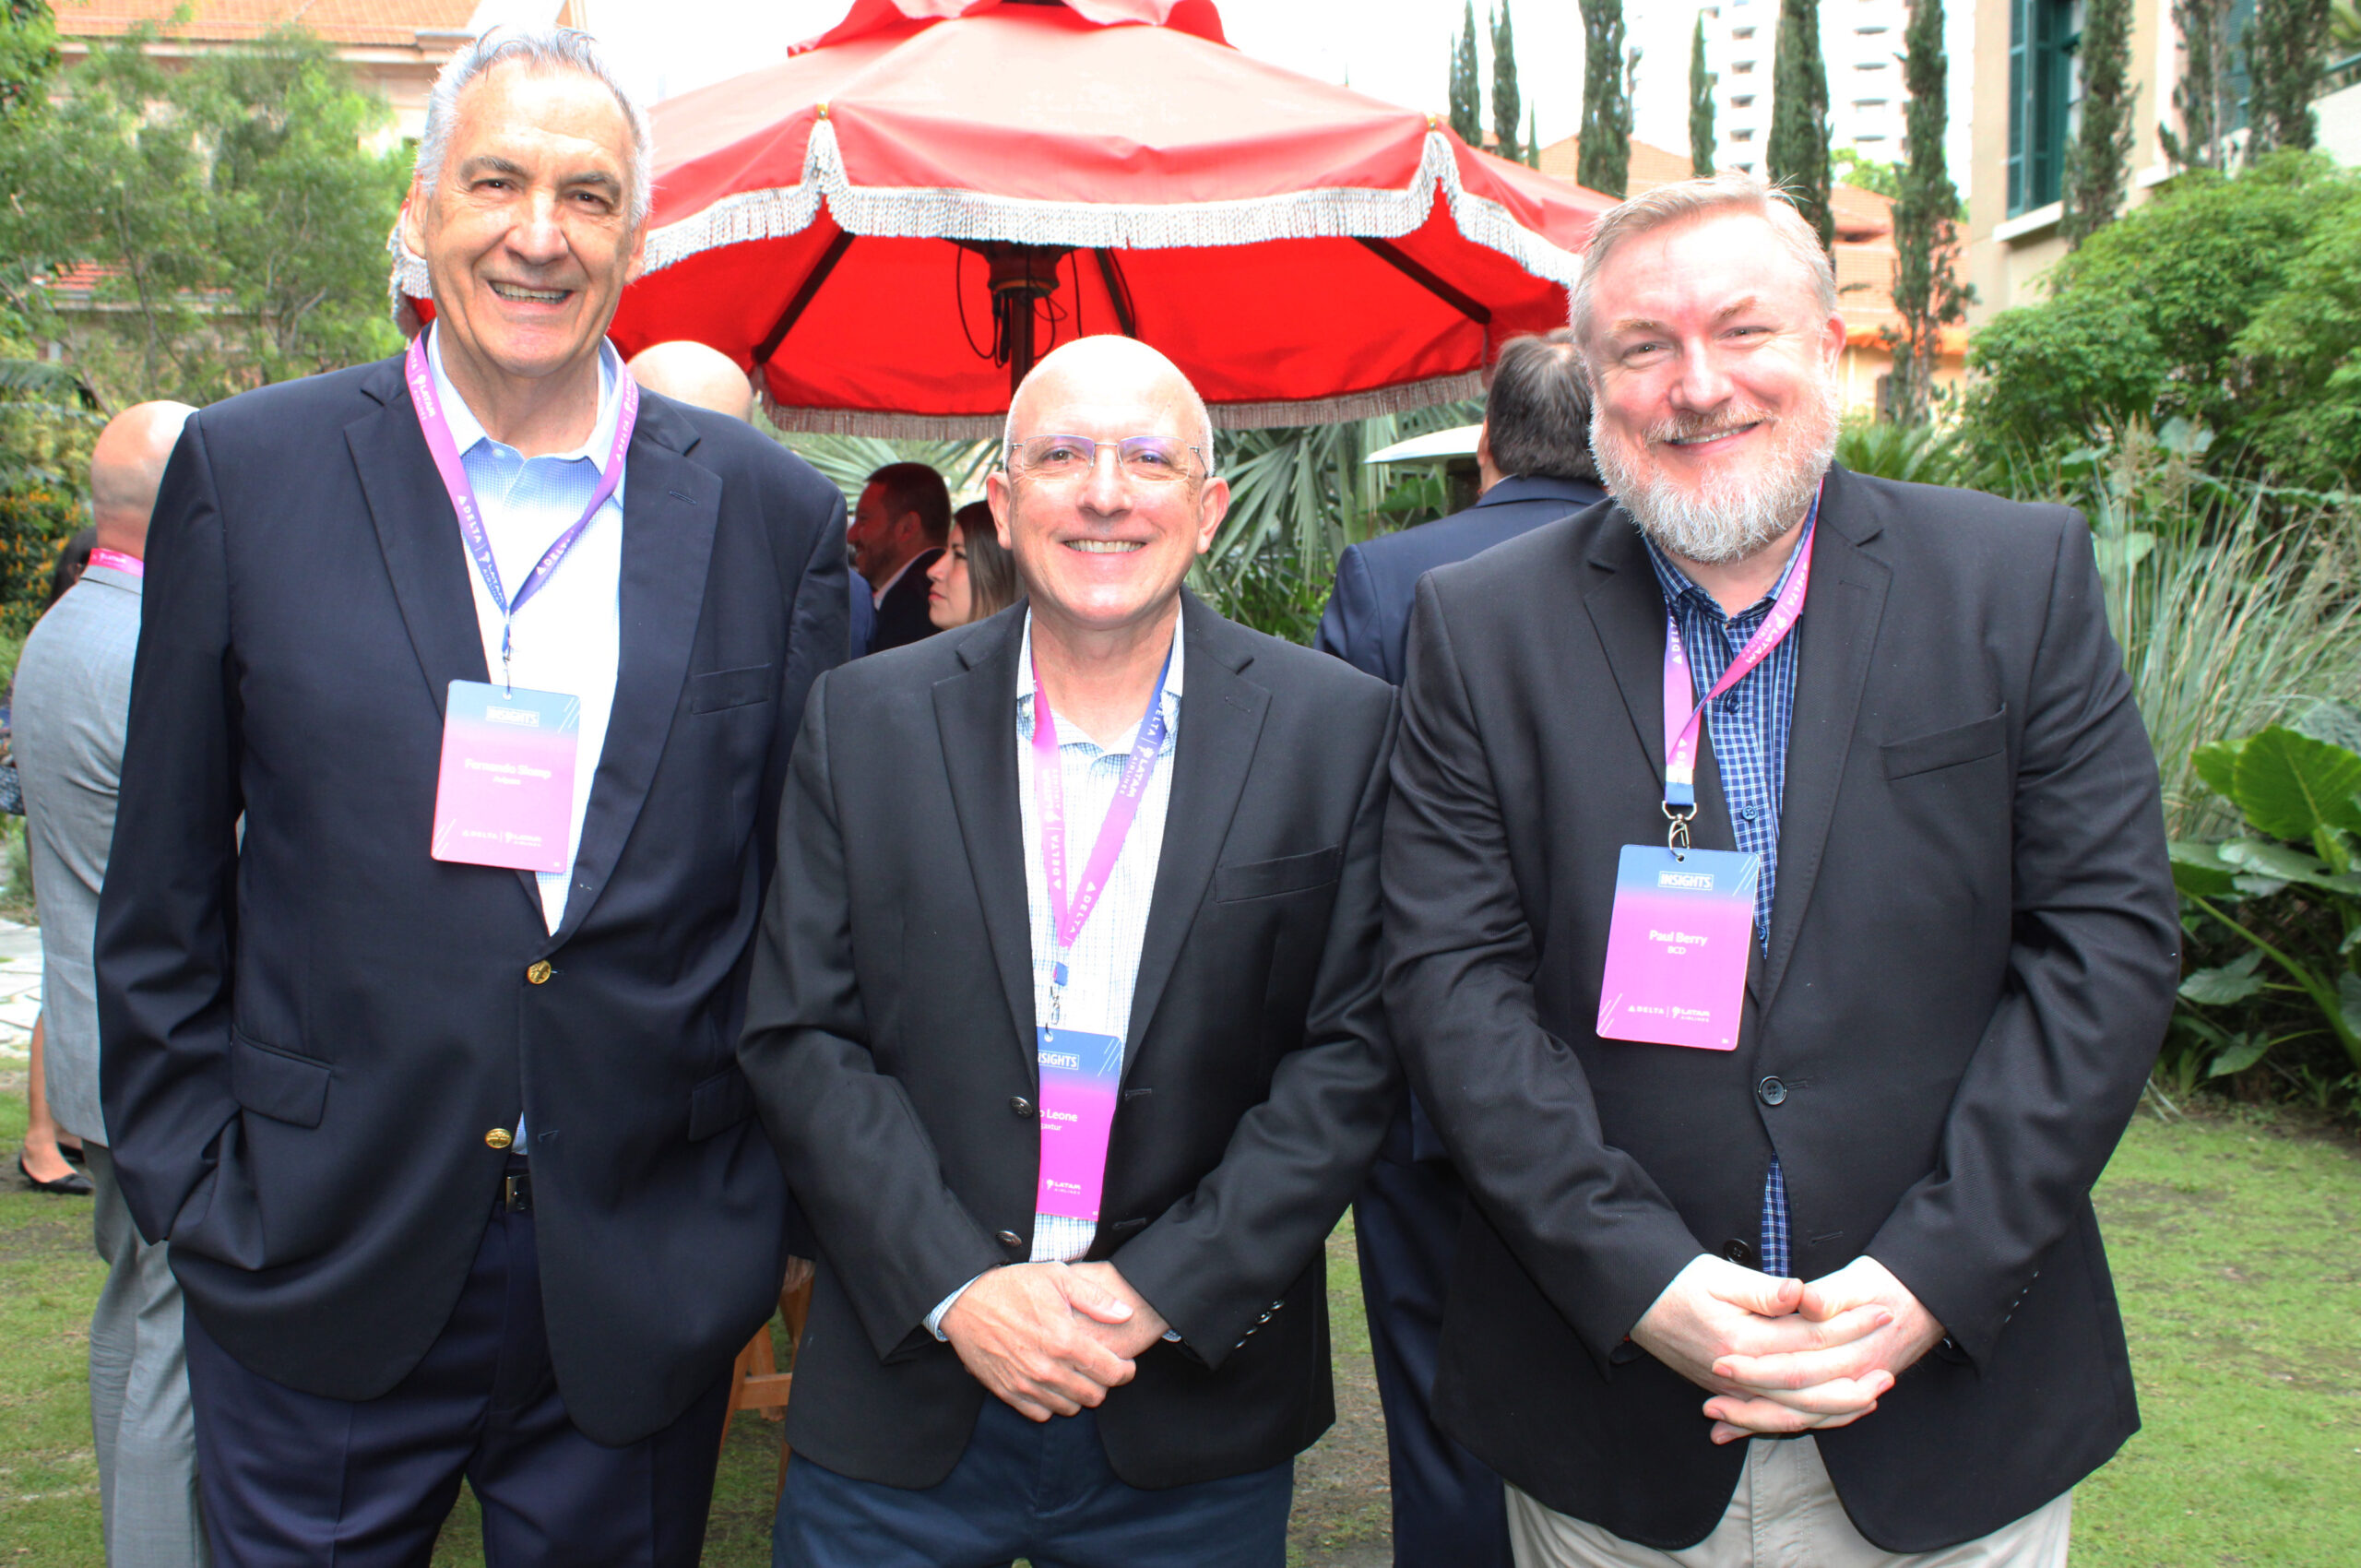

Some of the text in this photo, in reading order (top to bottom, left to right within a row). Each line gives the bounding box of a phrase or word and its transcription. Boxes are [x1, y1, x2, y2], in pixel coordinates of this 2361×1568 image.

[463, 505, 504, 603] DELTA LATAM
[543, 539, 570, 566] DELT
[1746, 572, 1806, 663] DELTA LATAM
[1126, 758, 1148, 798] LATAM
[1050, 835, 1061, 876] DELTA
[1660, 873, 1711, 888] INSIGHTS
[1070, 895, 1092, 933] DELTA
[1649, 930, 1709, 946] Paul Berry
[1667, 945, 1687, 956] BCD
[1636, 1005, 1665, 1015] DELTA
[1046, 1108, 1078, 1123] Leone
[1054, 1181, 1082, 1190] LATAM
